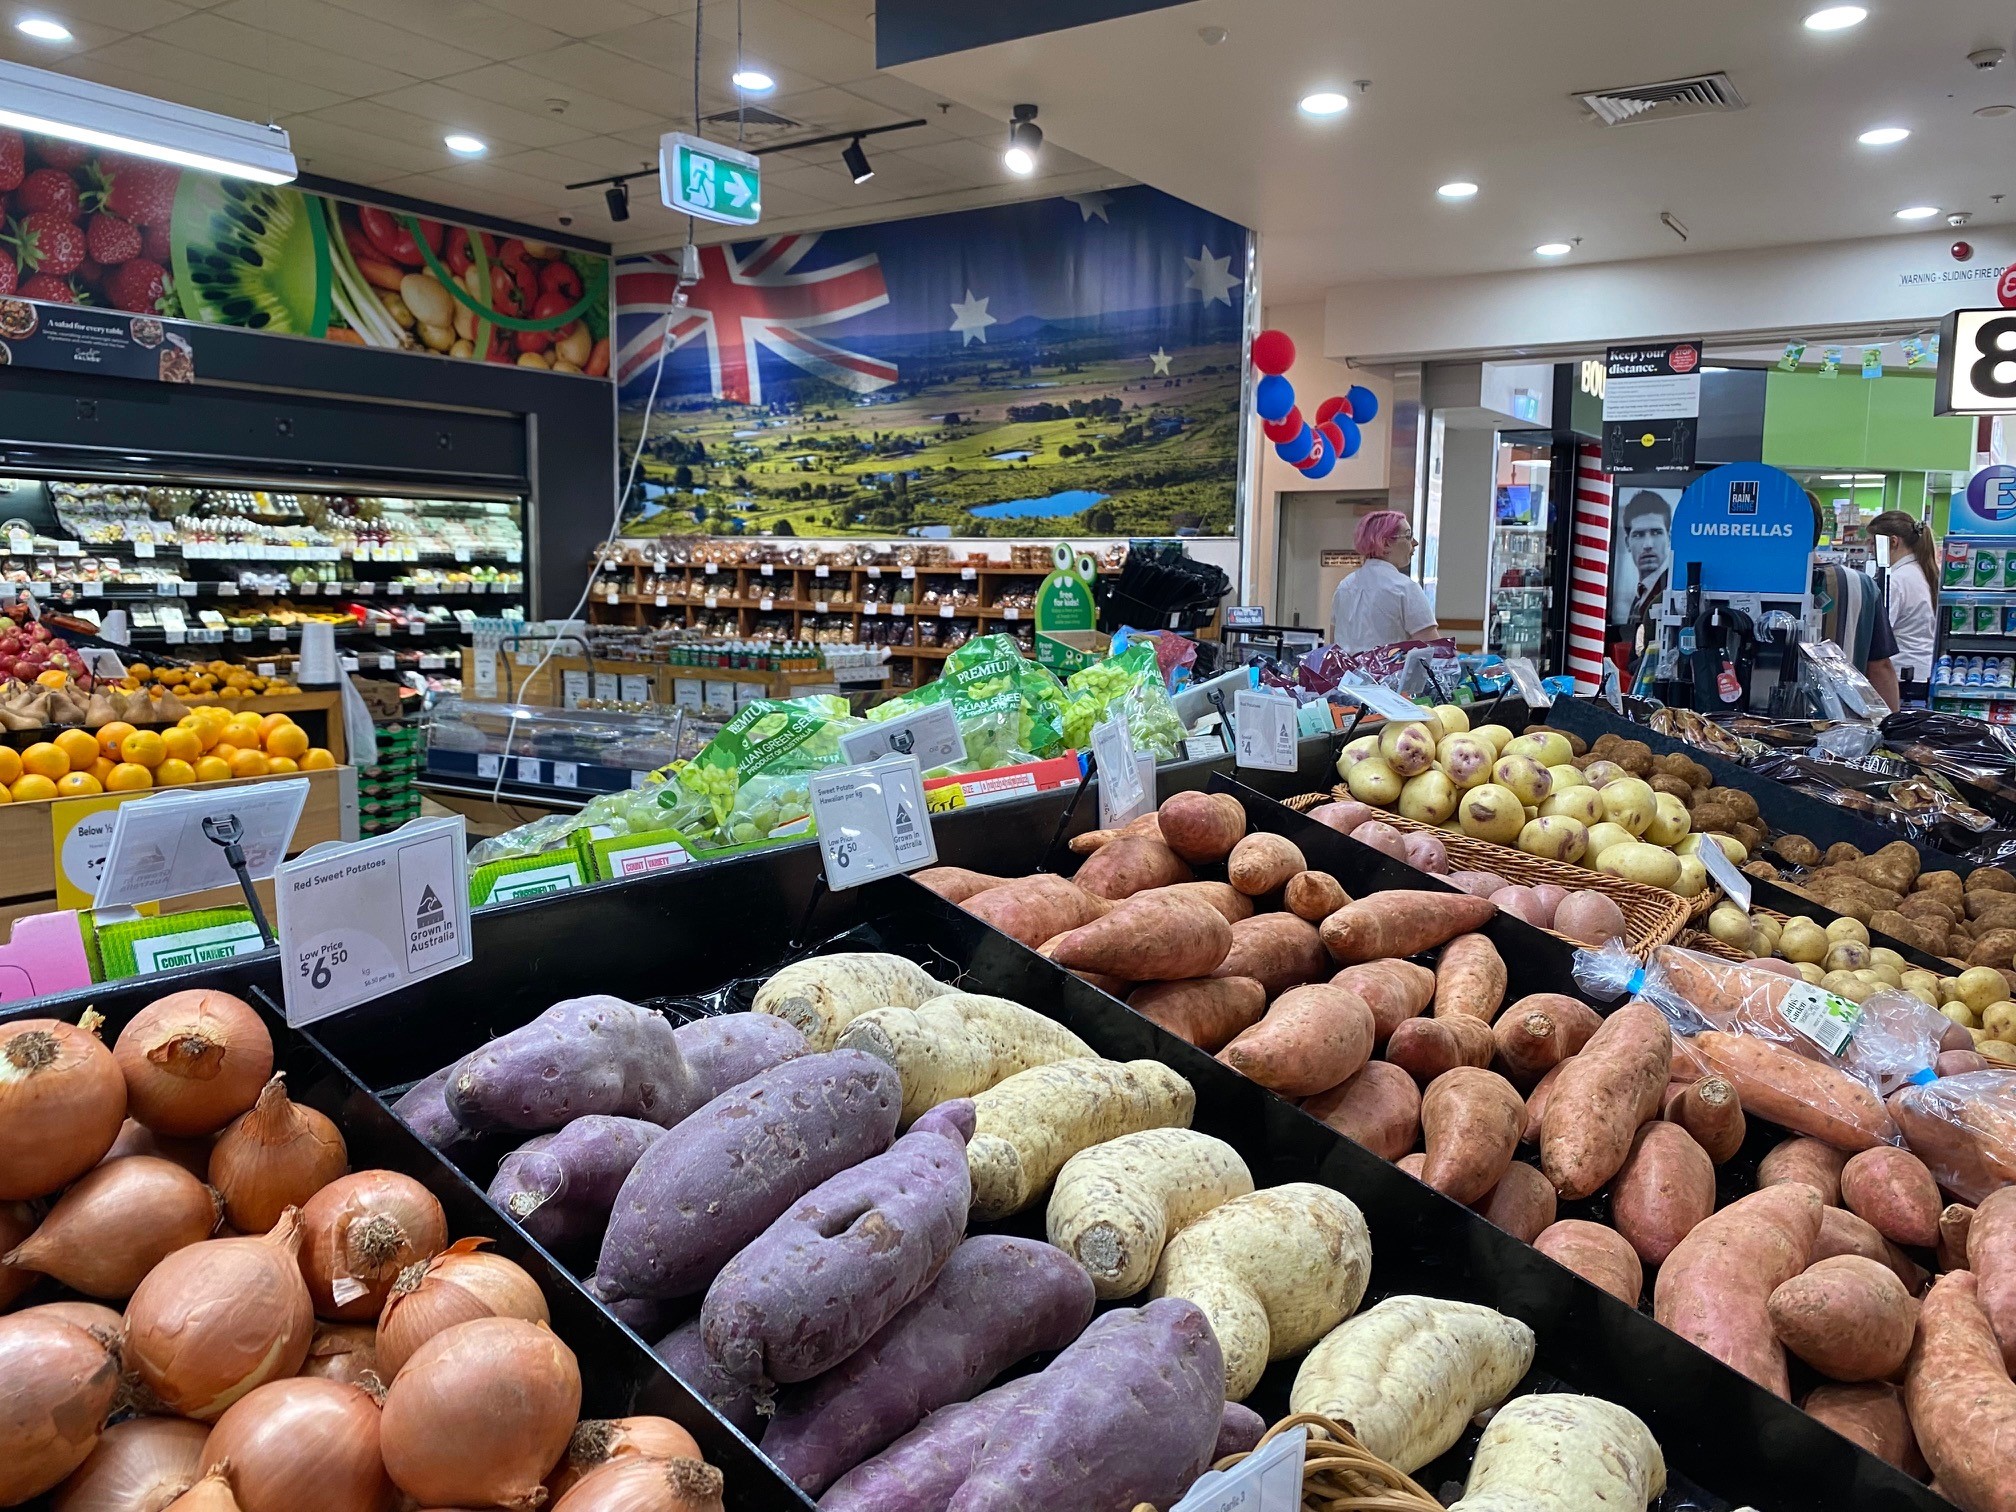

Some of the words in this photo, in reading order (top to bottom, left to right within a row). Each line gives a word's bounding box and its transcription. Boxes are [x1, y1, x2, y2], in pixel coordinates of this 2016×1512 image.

[1901, 273, 1936, 285] WARNING
[1942, 270, 1973, 282] SLIDING
[1974, 268, 1992, 279] FIRE
[1993, 267, 2007, 278] DO
[48, 319, 54, 327] A
[55, 321, 74, 329] salad
[74, 322, 85, 330] for
[86, 325, 105, 334] every
[106, 328, 124, 336] table
[1609, 350, 1638, 362] Keep
[1640, 349, 1667, 361] your
[1970, 316, 2016, 398] 8
[1608, 364, 1658, 375] distance.
[1732, 493, 1751, 503] RAIN
[1731, 502, 1754, 512] SHINE
[1690, 523, 1793, 537] UMBRELLAS
[762, 729, 794, 753] GREEN
[747, 756, 775, 776] PRODUCT
[774, 750, 783, 758] OF
[783, 727, 814, 752] AUSTRALIA
[817, 787, 836, 796] Sweet
[836, 783, 855, 793] Potato
[962, 785, 975, 794] SIZE
[819, 793, 845, 805] Hawaiian
[78, 824, 103, 837] Below
[828, 839, 840, 847] Low
[840, 835, 854, 844] Price
[893, 833, 914, 844] Grown
[913, 831, 920, 839] in
[895, 839, 923, 852] Australia
[626, 861, 644, 872] COUNT
[647, 856, 669, 868] VARIETY
[293, 877, 312, 892] Red
[314, 870, 344, 886] Sweet
[346, 857, 386, 876] Potatoes
[410, 924, 442, 943] Grown
[443, 920, 453, 931] in
[411, 931, 455, 954] Australia
[160, 953, 192, 969] COUNT
[198, 945, 236, 962] VARIETY
[300, 948, 319, 963] Low
[321, 940, 344, 955] Price
[361, 967, 371, 976] kg
[364, 976, 379, 987] $6.50
